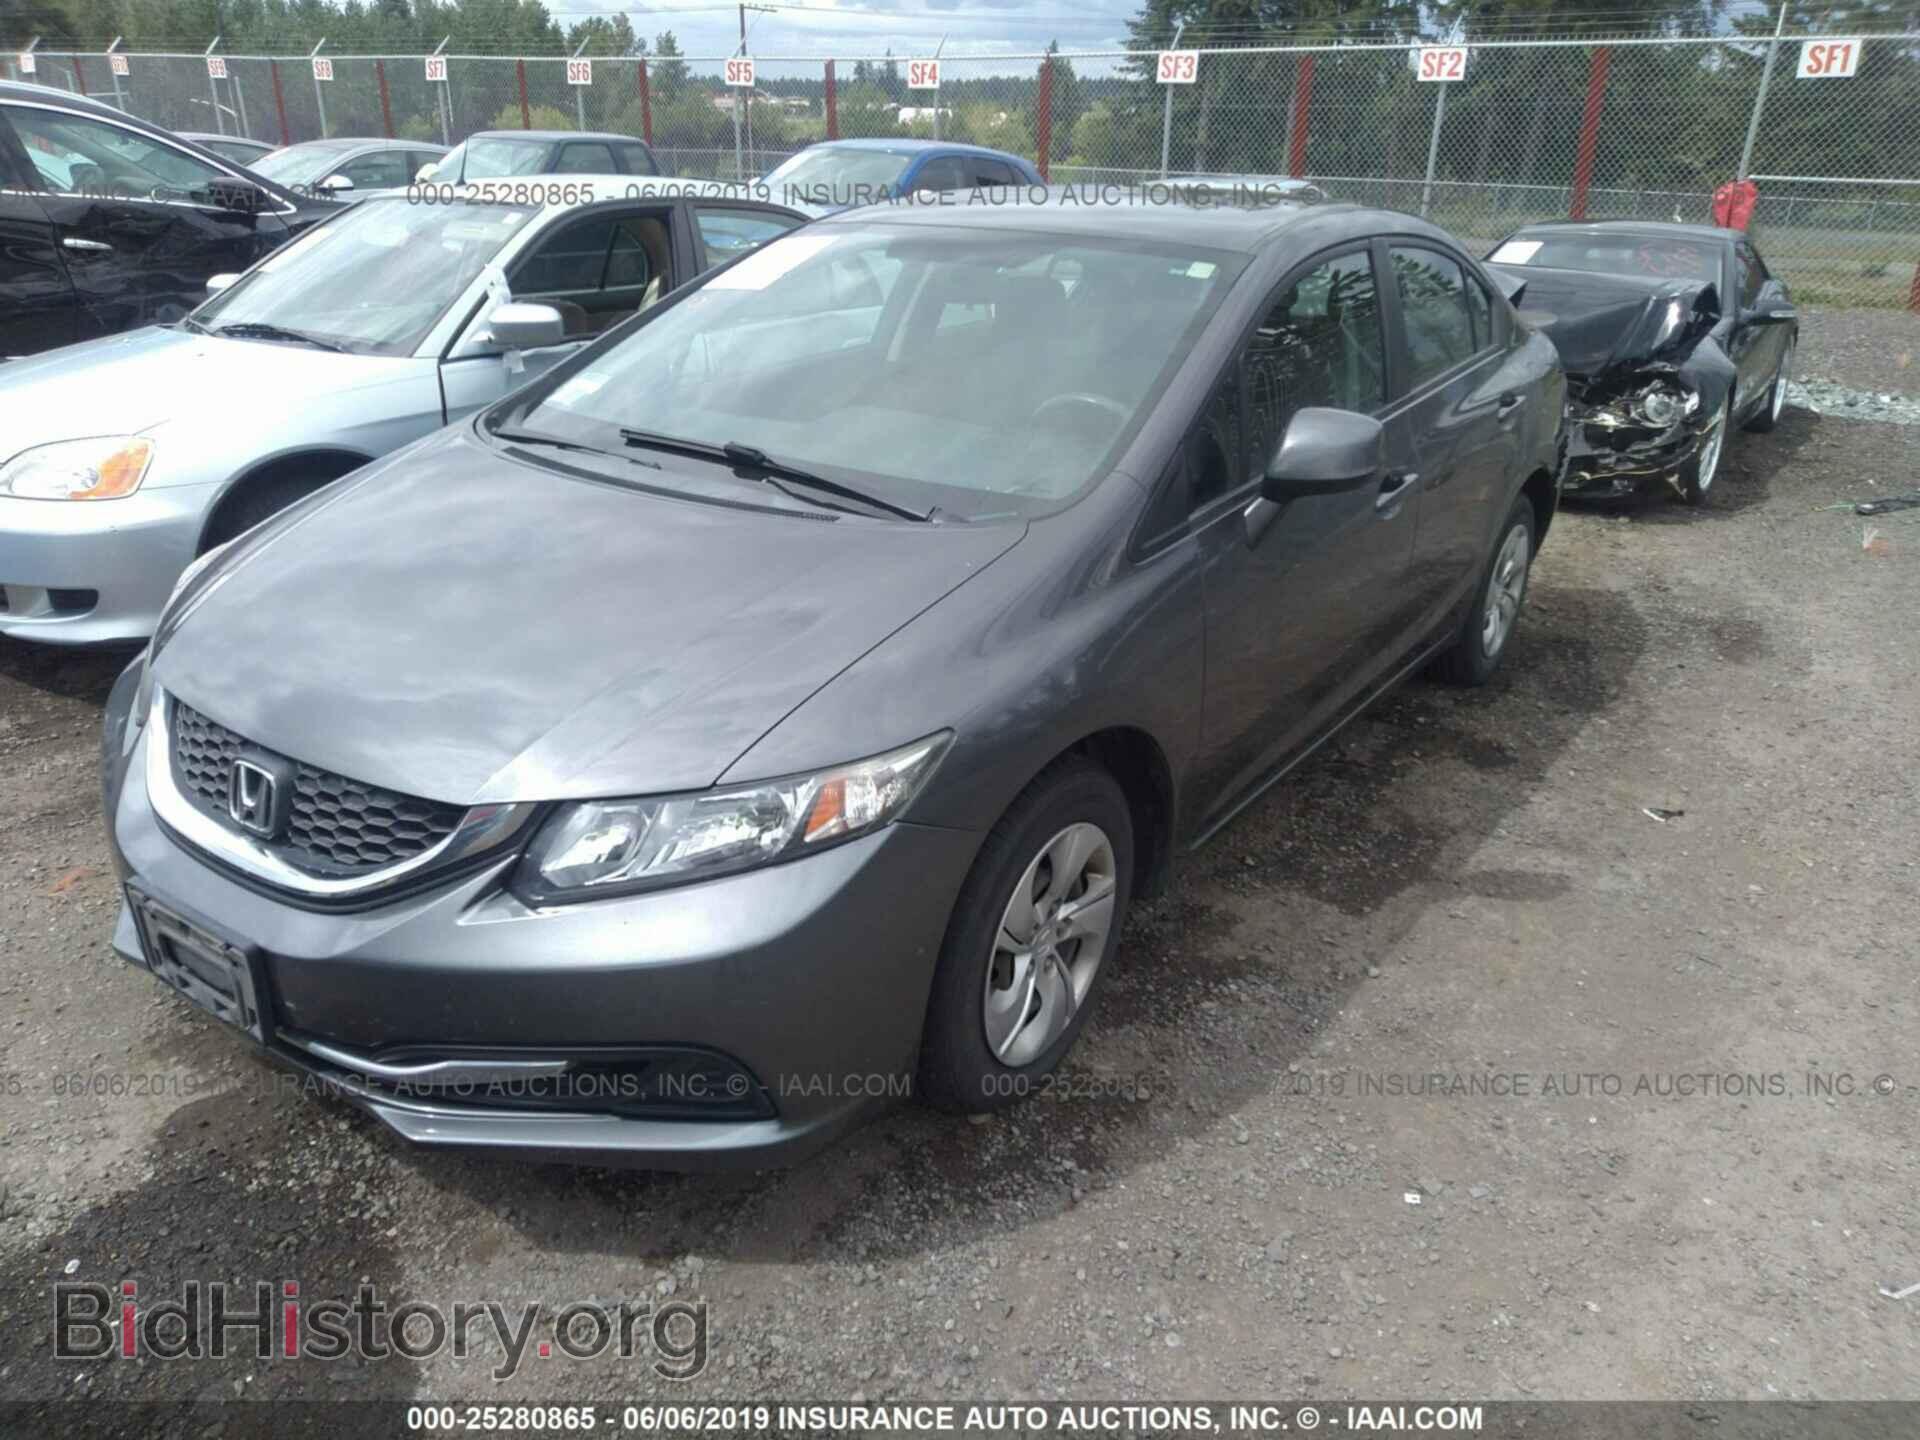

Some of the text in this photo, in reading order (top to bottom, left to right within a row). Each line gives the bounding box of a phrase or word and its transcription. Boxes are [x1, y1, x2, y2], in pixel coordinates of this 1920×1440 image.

[428, 60, 443, 78] SF7
[1161, 55, 1195, 79] SF3
[1422, 51, 1463, 78] SF2
[1806, 44, 1852, 74] SF1
[569, 62, 590, 81] SF6
[727, 62, 752, 82] SF5
[911, 63, 938, 84] SF4
